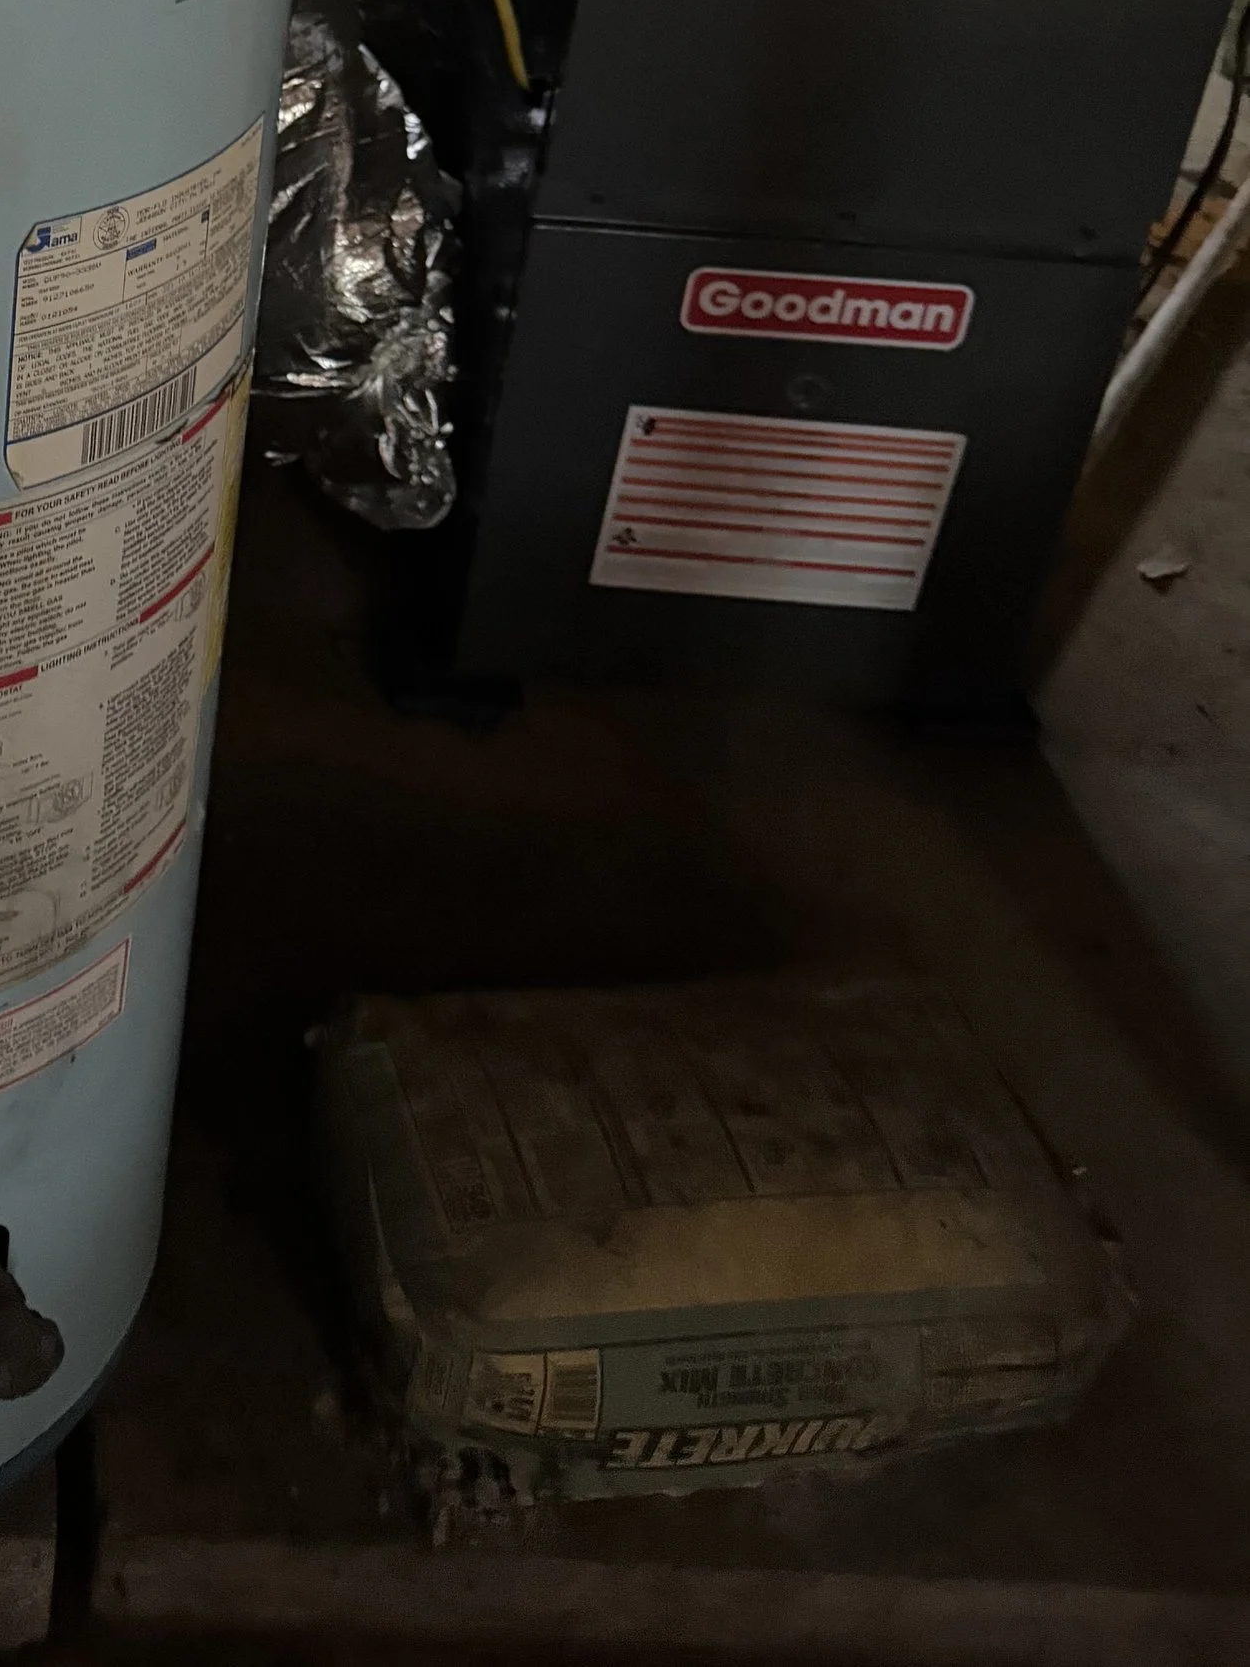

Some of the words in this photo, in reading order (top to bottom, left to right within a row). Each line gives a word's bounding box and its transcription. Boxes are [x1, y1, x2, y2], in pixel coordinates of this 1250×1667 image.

[698, 280, 955, 333] Goodman
[14, 507, 34, 519] FOR
[36, 499, 62, 513] YOUR
[63, 486, 96, 504] SAFETY
[120, 459, 148, 480] BEFORE
